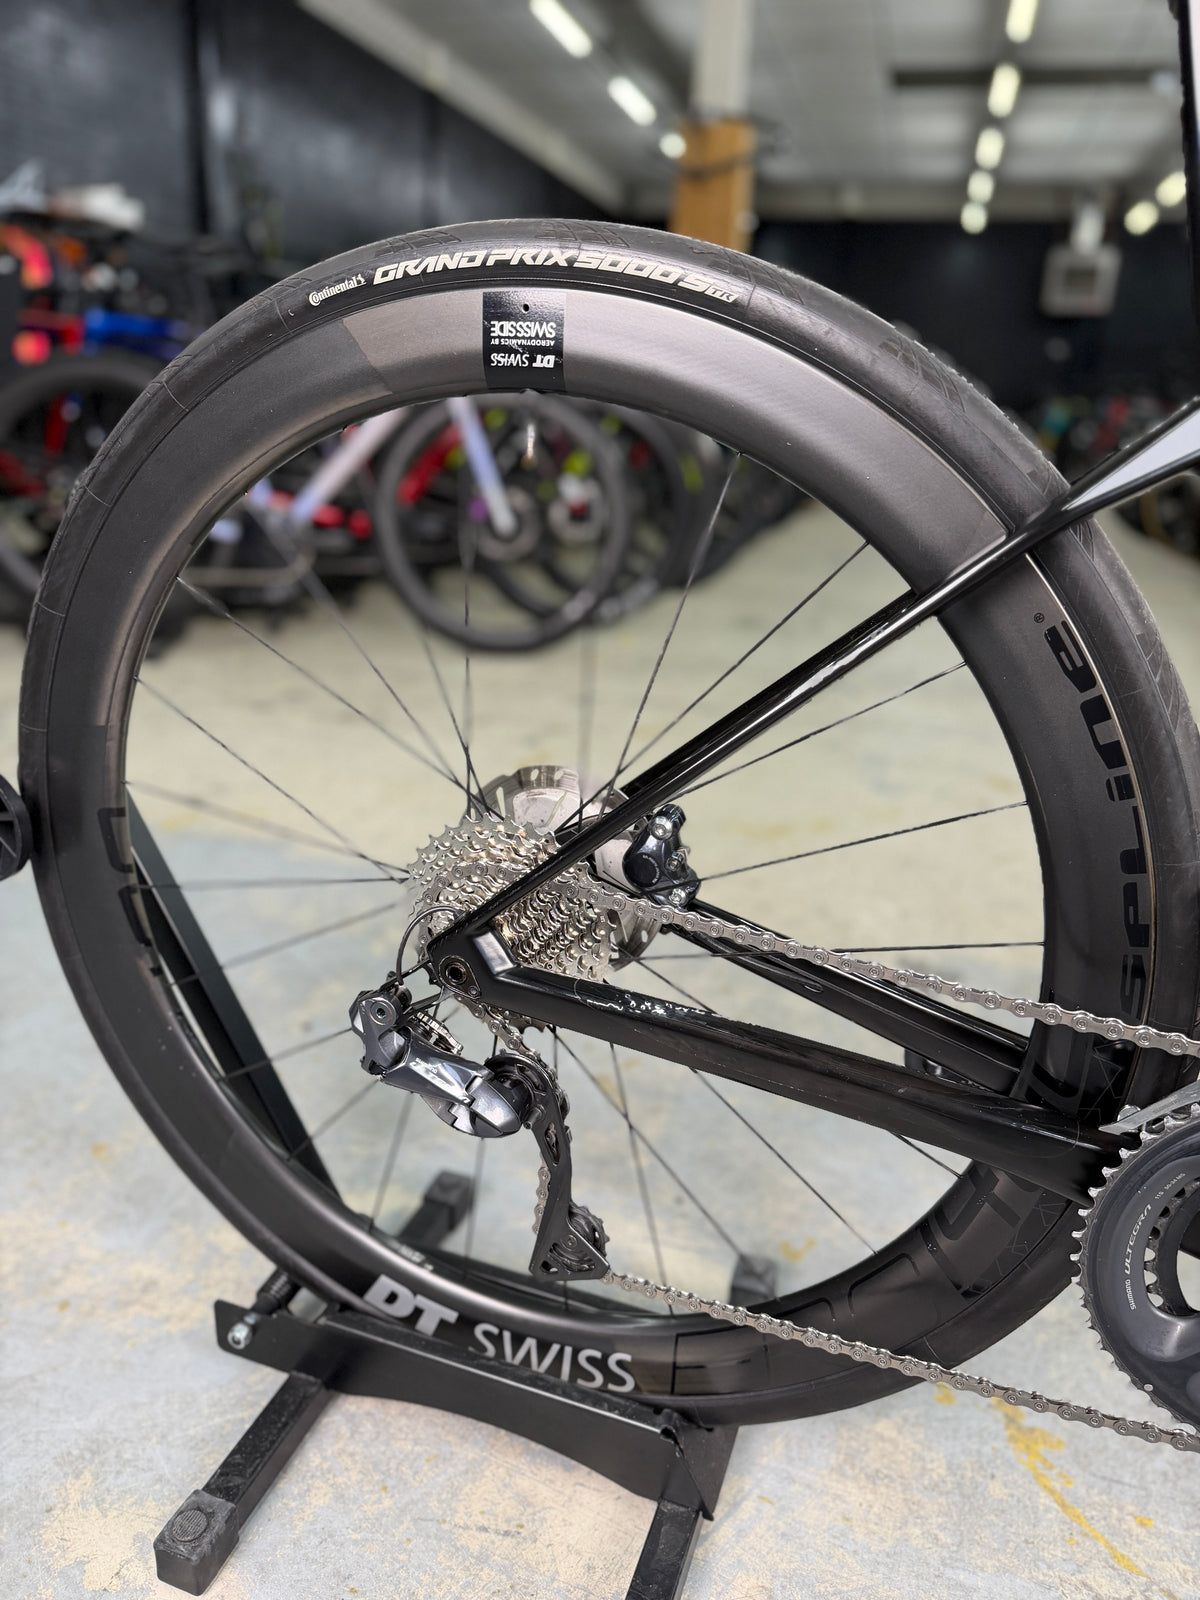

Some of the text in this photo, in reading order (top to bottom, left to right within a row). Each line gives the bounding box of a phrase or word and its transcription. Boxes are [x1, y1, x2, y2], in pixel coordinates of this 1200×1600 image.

[373, 249, 487, 285] GRAND
[485, 247, 581, 269] PRIX
[572, 249, 685, 285] 5000
[308, 276, 359, 306] Continental
[500, 338, 556, 347] AERODYNAMICS
[490, 353, 556, 368] DT SWISS
[1124, 1203, 1152, 1275] ULTEGRA
[1124, 1279, 1137, 1310] SHIMANO
[363, 1274, 459, 1337] DT
[468, 1323, 636, 1393] SWISS
